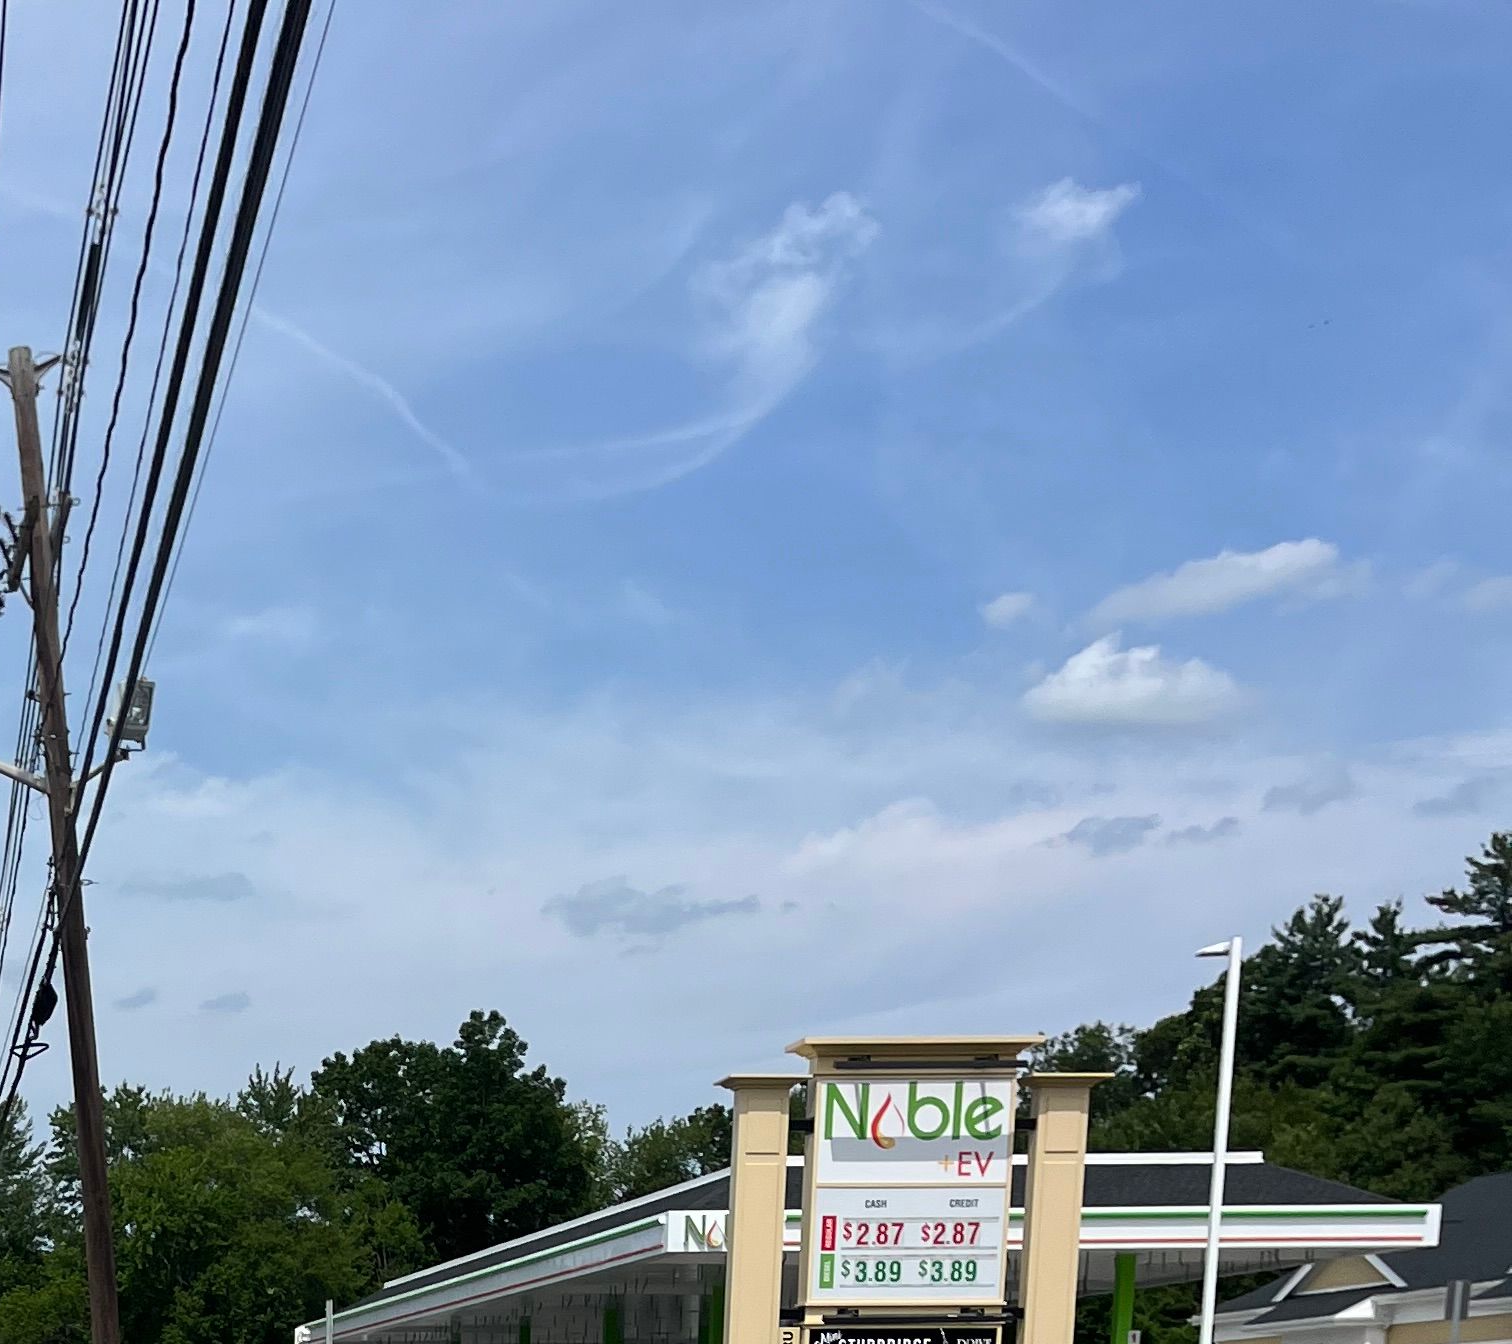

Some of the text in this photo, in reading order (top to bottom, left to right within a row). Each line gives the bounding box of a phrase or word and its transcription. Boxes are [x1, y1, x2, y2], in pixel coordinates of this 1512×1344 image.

[824, 1081, 1004, 1149] Noble
[864, 1199, 979, 1208] CASH CREDIT
[842, 1222, 981, 1245] $2.87 $2.87
[841, 1259, 977, 1283] $3.89 $3.89
